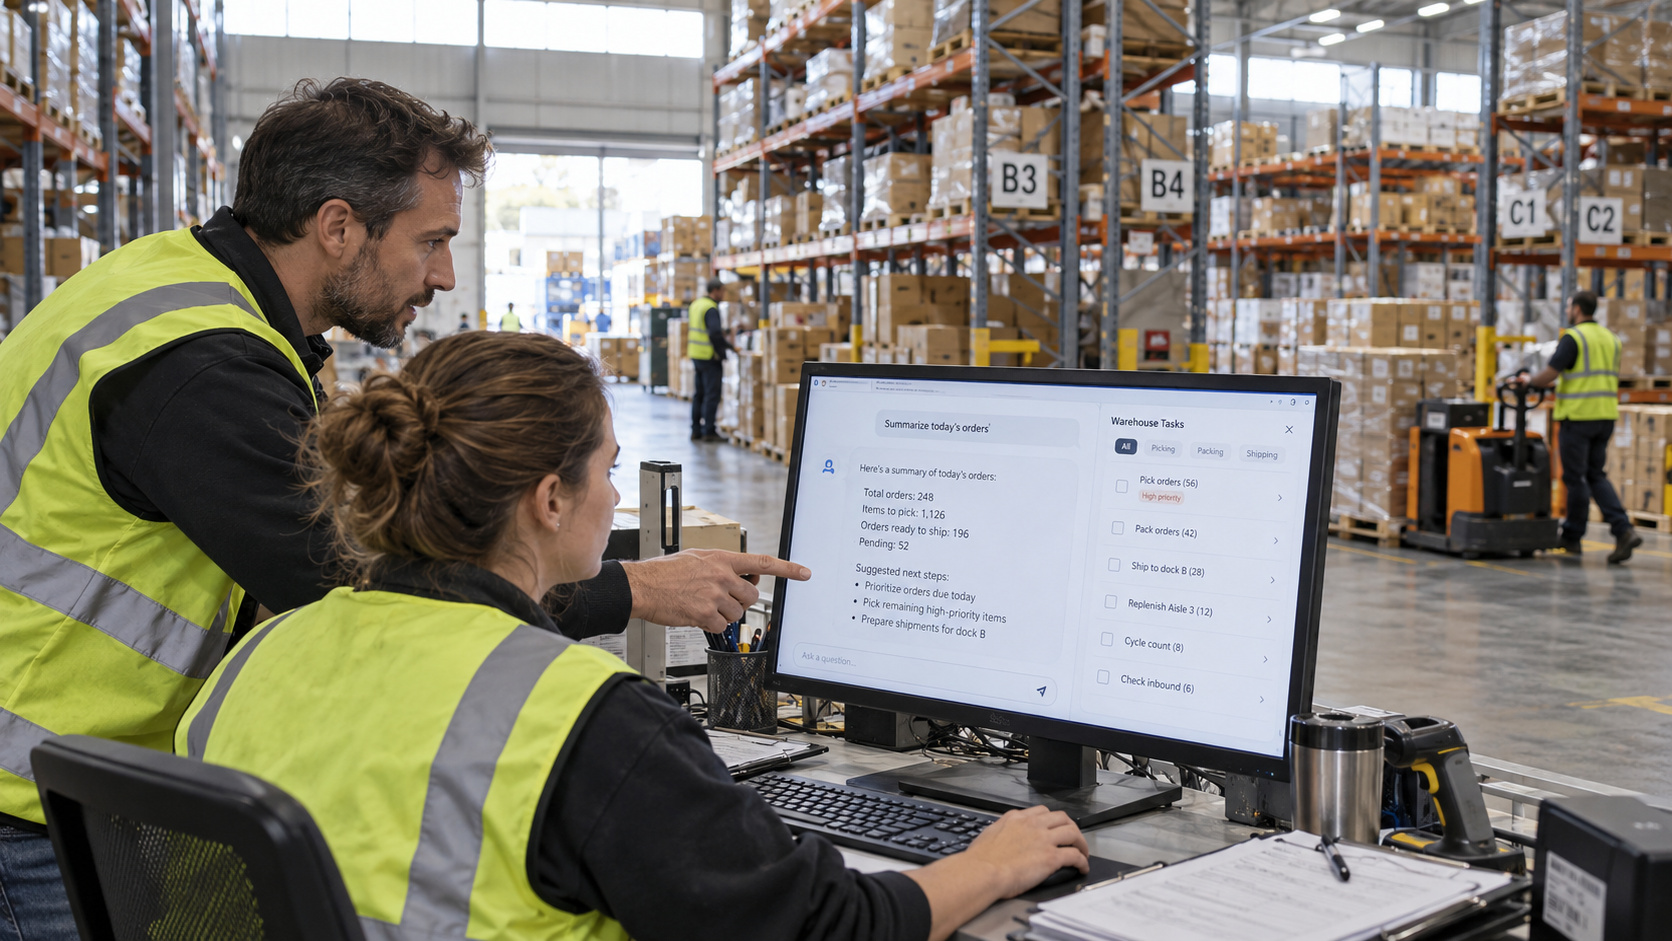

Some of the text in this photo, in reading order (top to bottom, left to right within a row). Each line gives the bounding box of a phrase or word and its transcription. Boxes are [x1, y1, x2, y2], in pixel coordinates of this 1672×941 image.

[1003, 164, 1036, 193] B3
[1152, 170, 1184, 198] B4
[1511, 199, 1535, 225] C1
[1587, 206, 1614, 233] C2
[884, 420, 929, 430] Summarize
[931, 422, 960, 433] today's
[1111, 417, 1184, 428] Warehouse Tasks
[1152, 444, 1176, 454] Picking
[1198, 447, 1224, 457] Packing
[1246, 449, 1278, 460] Shipping
[860, 464, 883, 474] Here's
[892, 467, 927, 478] summary
[929, 468, 937, 477] of
[938, 470, 967, 481] today's
[968, 471, 996, 482] orders:
[1140, 476, 1198, 488] Pick orders (56)
[864, 488, 934, 502] Total orders: 248
[862, 505, 945, 520] Items to pick: 1,126
[861, 521, 969, 539] Orders ready to ship: 196
[1135, 525, 1197, 538] Pack orders (42)
[859, 537, 909, 551] Pending: 52
[856, 563, 949, 582] Suggested next steps:
[1132, 562, 1149, 573] Ship
[1150, 564, 1159, 572] to
[1160, 564, 1180, 574] dock
[1189, 567, 1205, 577] (28)
[865, 581, 976, 604] Prioritize orders due today
[863, 597, 1007, 624] Pick remaining high-priority items
[1128, 599, 1213, 618] Replenish Aisle 3 (12)
[861, 614, 986, 639] Prepare shipments for dock B
[1124, 637, 1184, 653] Cycle count (8)
[1121, 674, 1194, 694] Check inbound (6)
